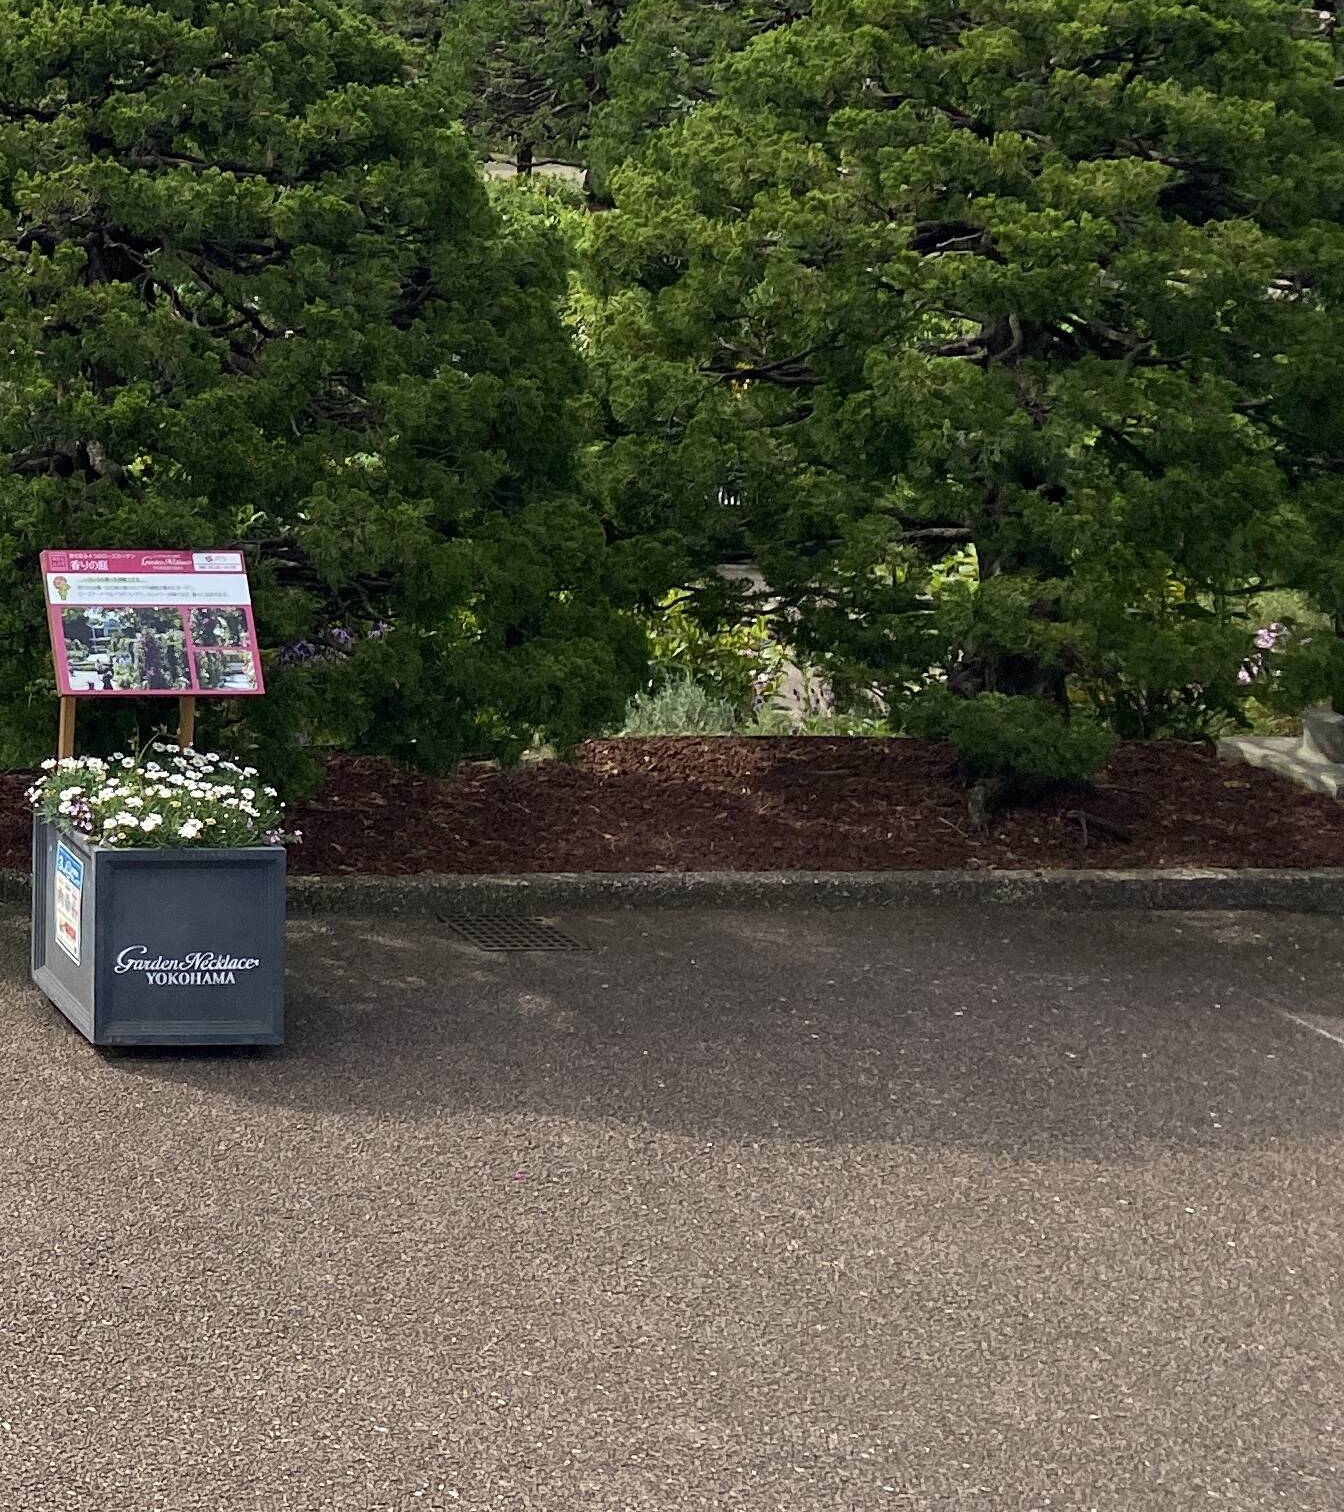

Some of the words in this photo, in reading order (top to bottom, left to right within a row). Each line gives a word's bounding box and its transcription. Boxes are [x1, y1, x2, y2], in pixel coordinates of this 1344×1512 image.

[70, 559, 109, 571] 香りの庭
[114, 944, 179, 974] Garden
[178, 951, 259, 971] Necklace
[145, 971, 236, 986] YOKOHAMA
